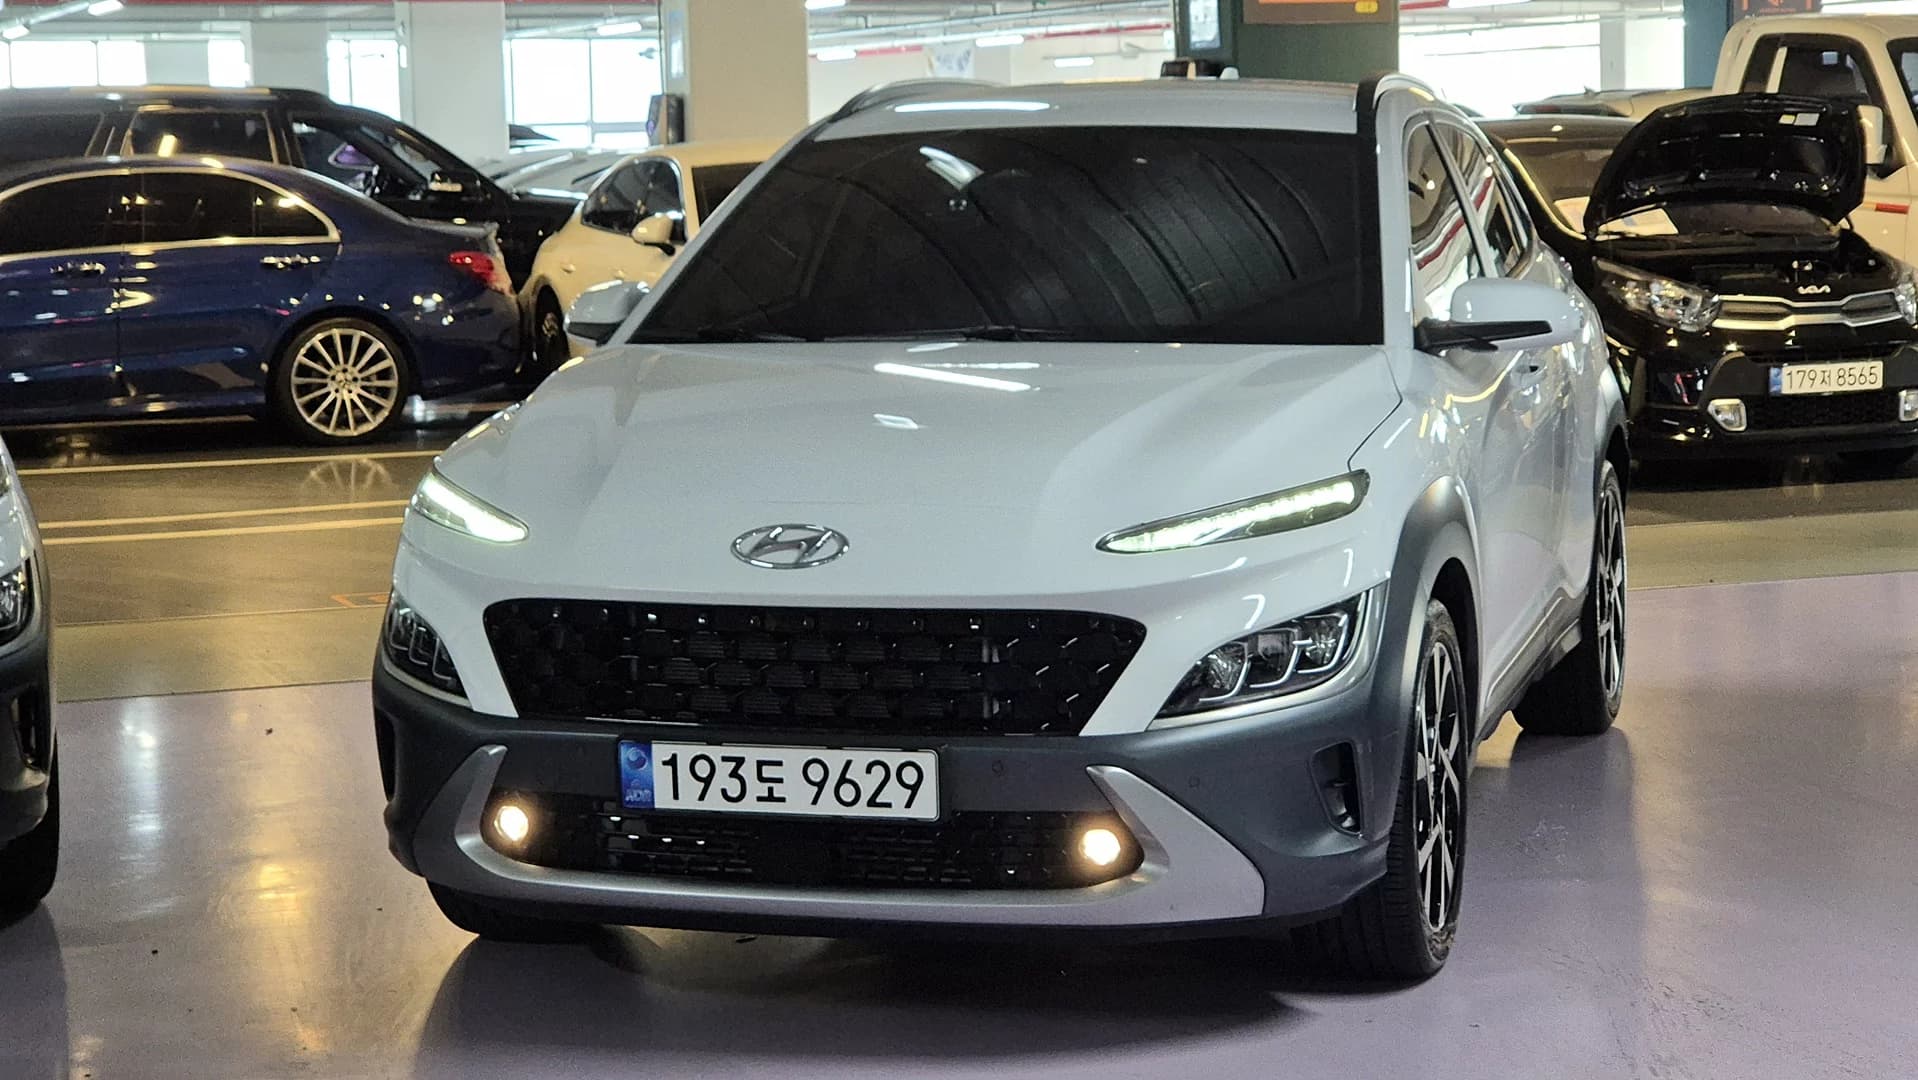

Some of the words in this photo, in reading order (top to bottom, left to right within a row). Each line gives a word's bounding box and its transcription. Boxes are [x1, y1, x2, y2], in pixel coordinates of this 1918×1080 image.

[1786, 369, 1832, 389] 179저
[1836, 366, 1878, 386] 8565
[661, 753, 786, 803] 193도
[801, 757, 924, 809] 9629
